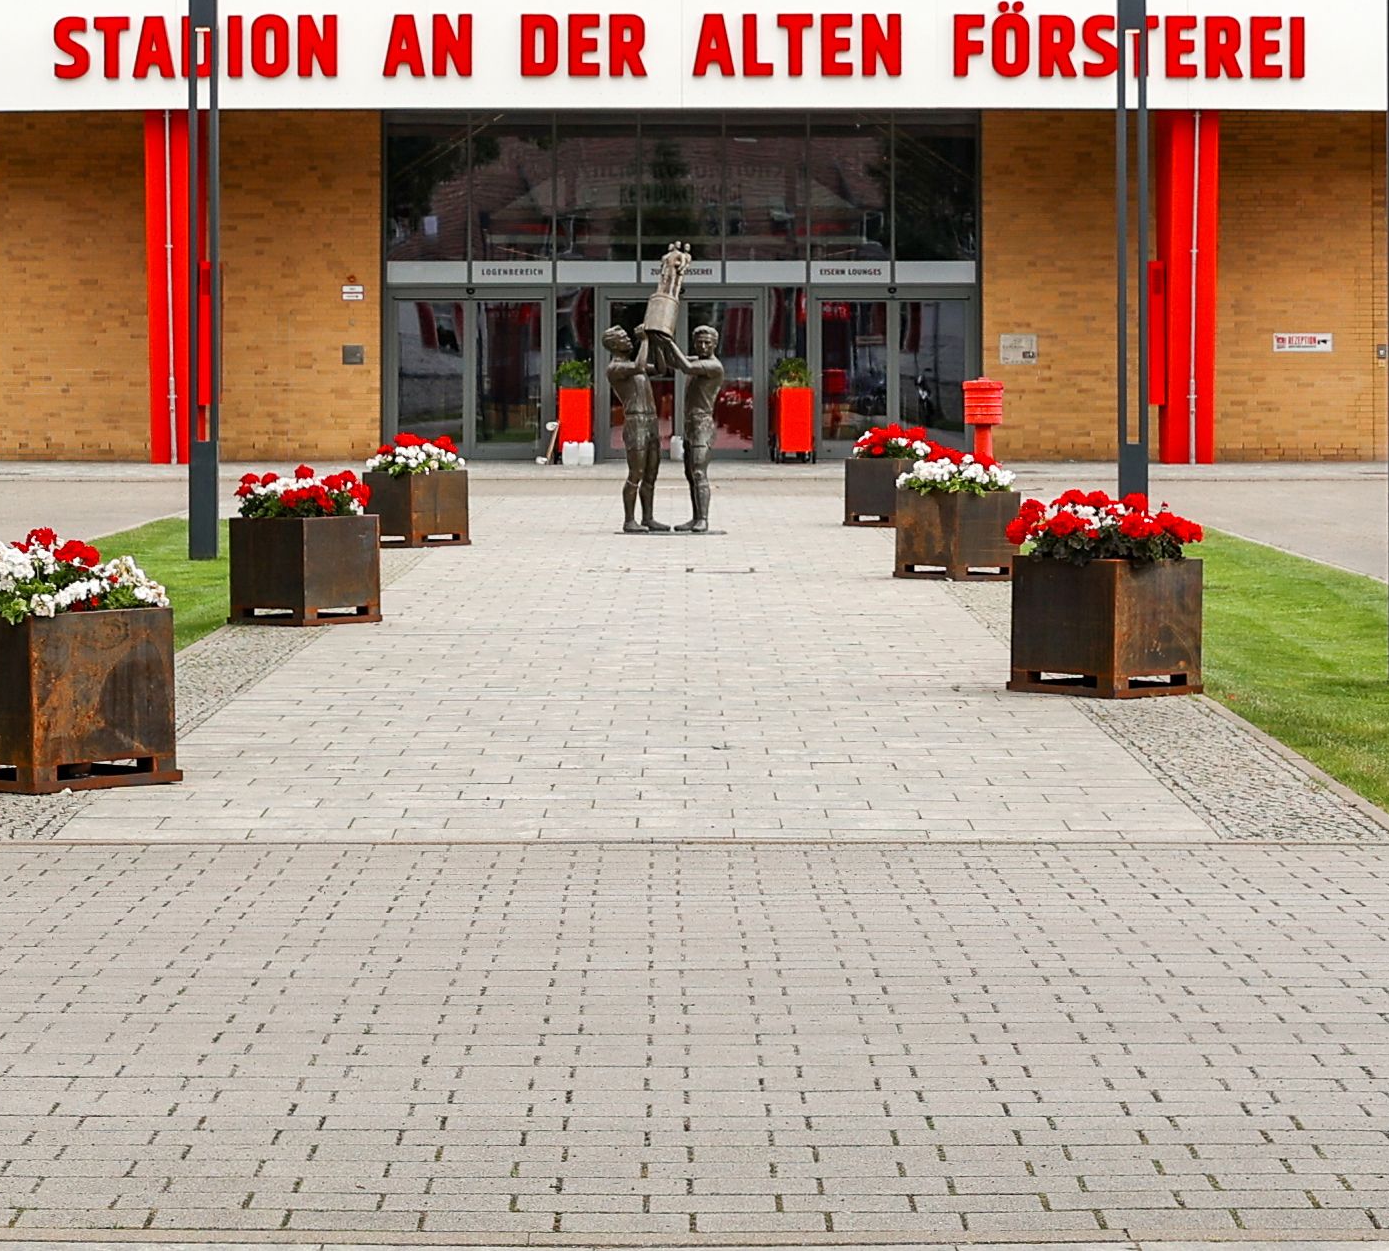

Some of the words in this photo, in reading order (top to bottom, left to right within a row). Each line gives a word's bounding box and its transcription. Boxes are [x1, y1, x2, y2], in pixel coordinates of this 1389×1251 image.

[382, 13, 473, 78] AN
[520, 13, 648, 77] DER
[692, 13, 902, 77] ALTEN
[481, 268, 544, 276] LOGENBEREICH
[819, 268, 846, 276] EISERN
[848, 268, 882, 276] LOUNGES
